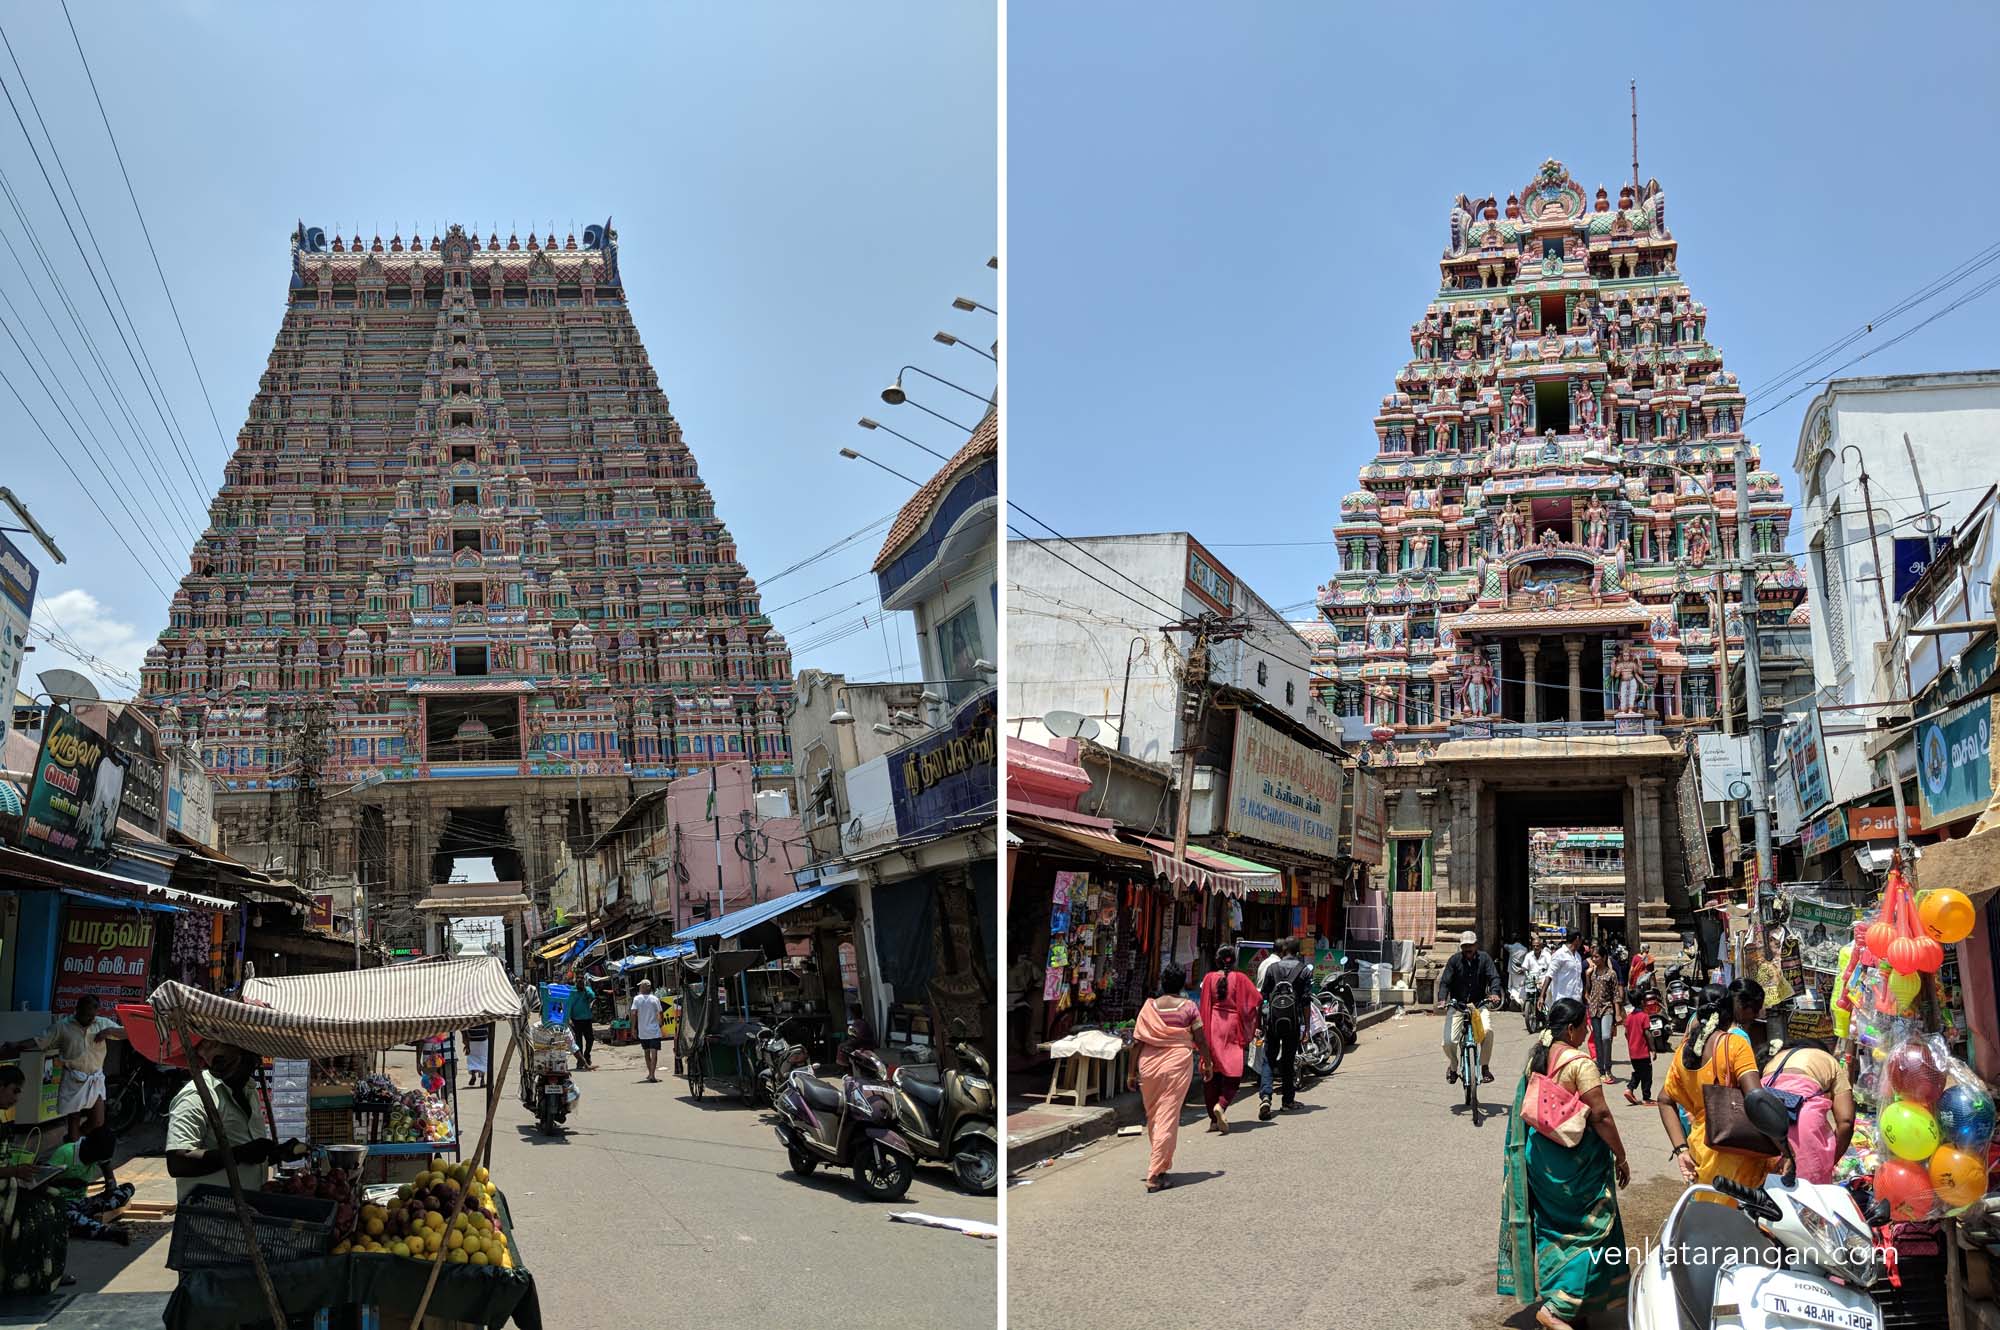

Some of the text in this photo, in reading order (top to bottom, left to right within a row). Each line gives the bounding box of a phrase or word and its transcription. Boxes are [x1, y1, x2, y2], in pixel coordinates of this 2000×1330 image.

[1303, 816, 1334, 841] TEXTILES
[68, 919, 153, 953] யாதவா
[64, 956, 145, 976] நெய் ஸ்டோர்
[1794, 1282, 1833, 1298] HONDA
